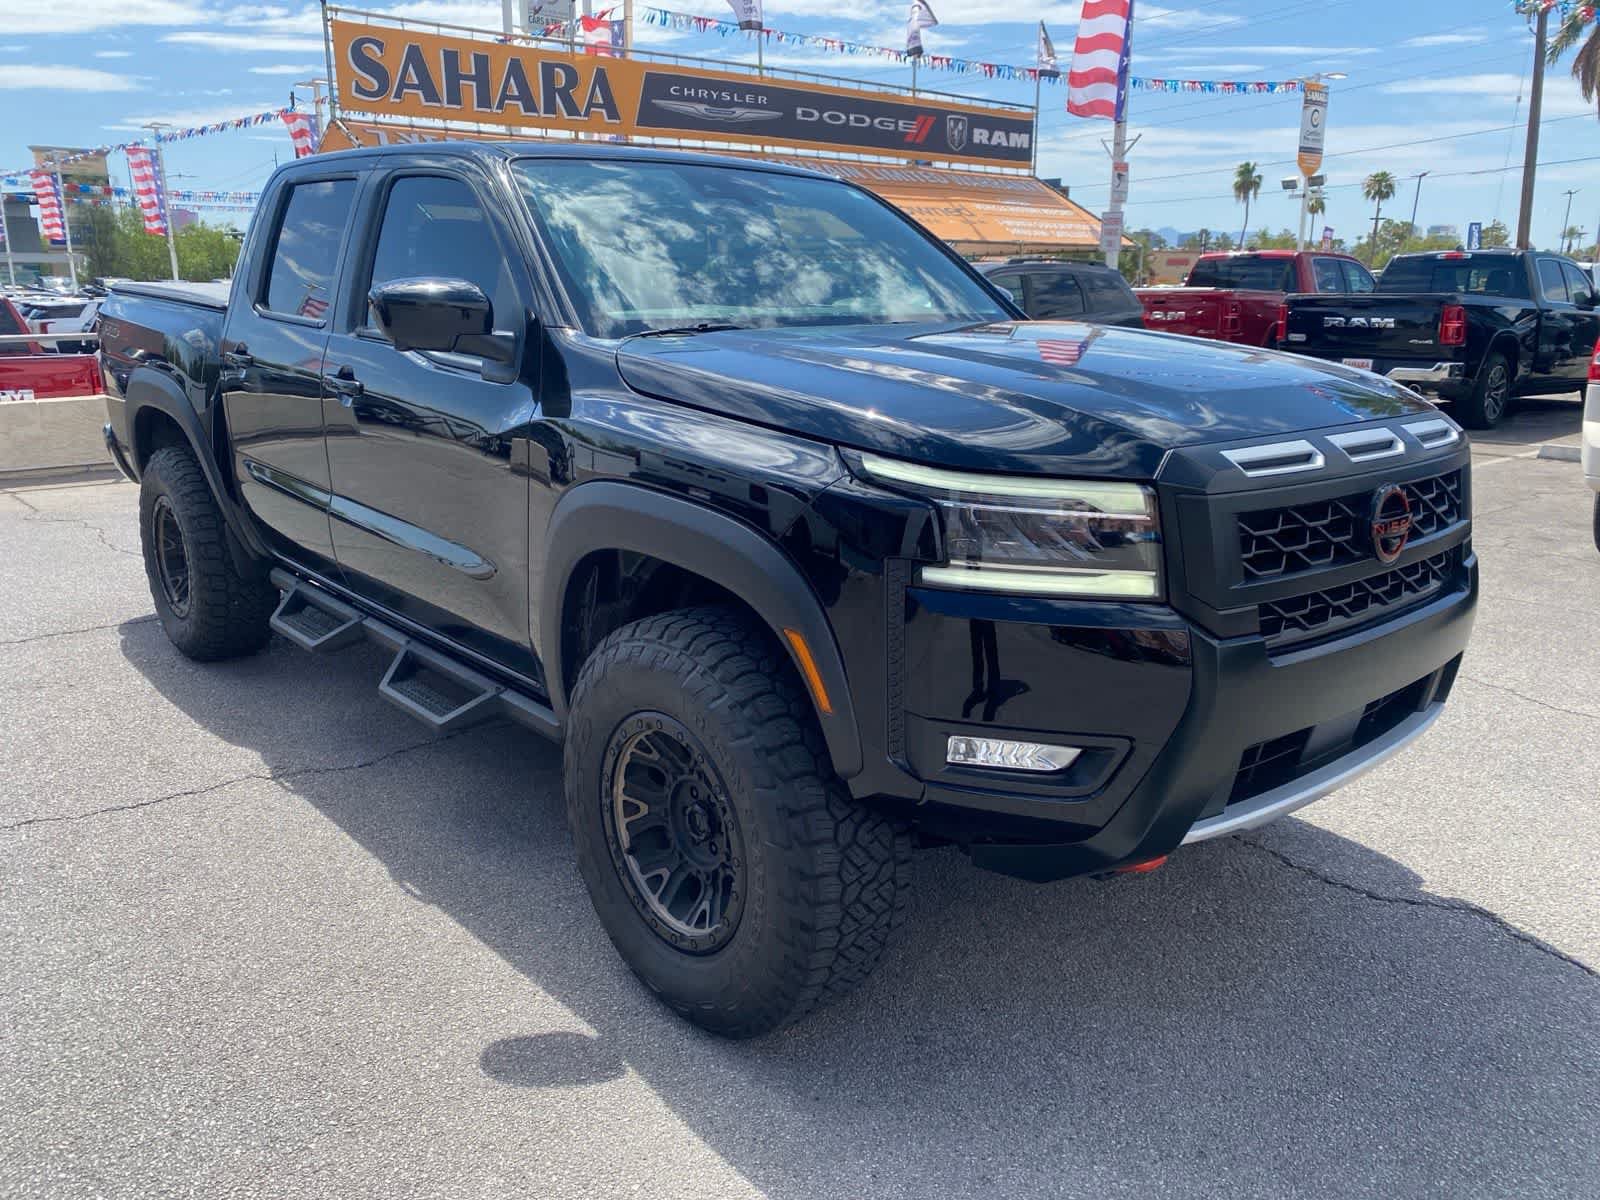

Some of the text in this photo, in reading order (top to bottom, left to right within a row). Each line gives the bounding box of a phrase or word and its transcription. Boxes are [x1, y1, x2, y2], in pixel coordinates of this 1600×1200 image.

[347, 36, 622, 124] SAHARA
[669, 85, 769, 106] CHRYSLER
[795, 107, 918, 132] DODGE
[972, 127, 1031, 149] RAM
[1323, 316, 1395, 329] RAM
[1373, 519, 1410, 535] NISS
